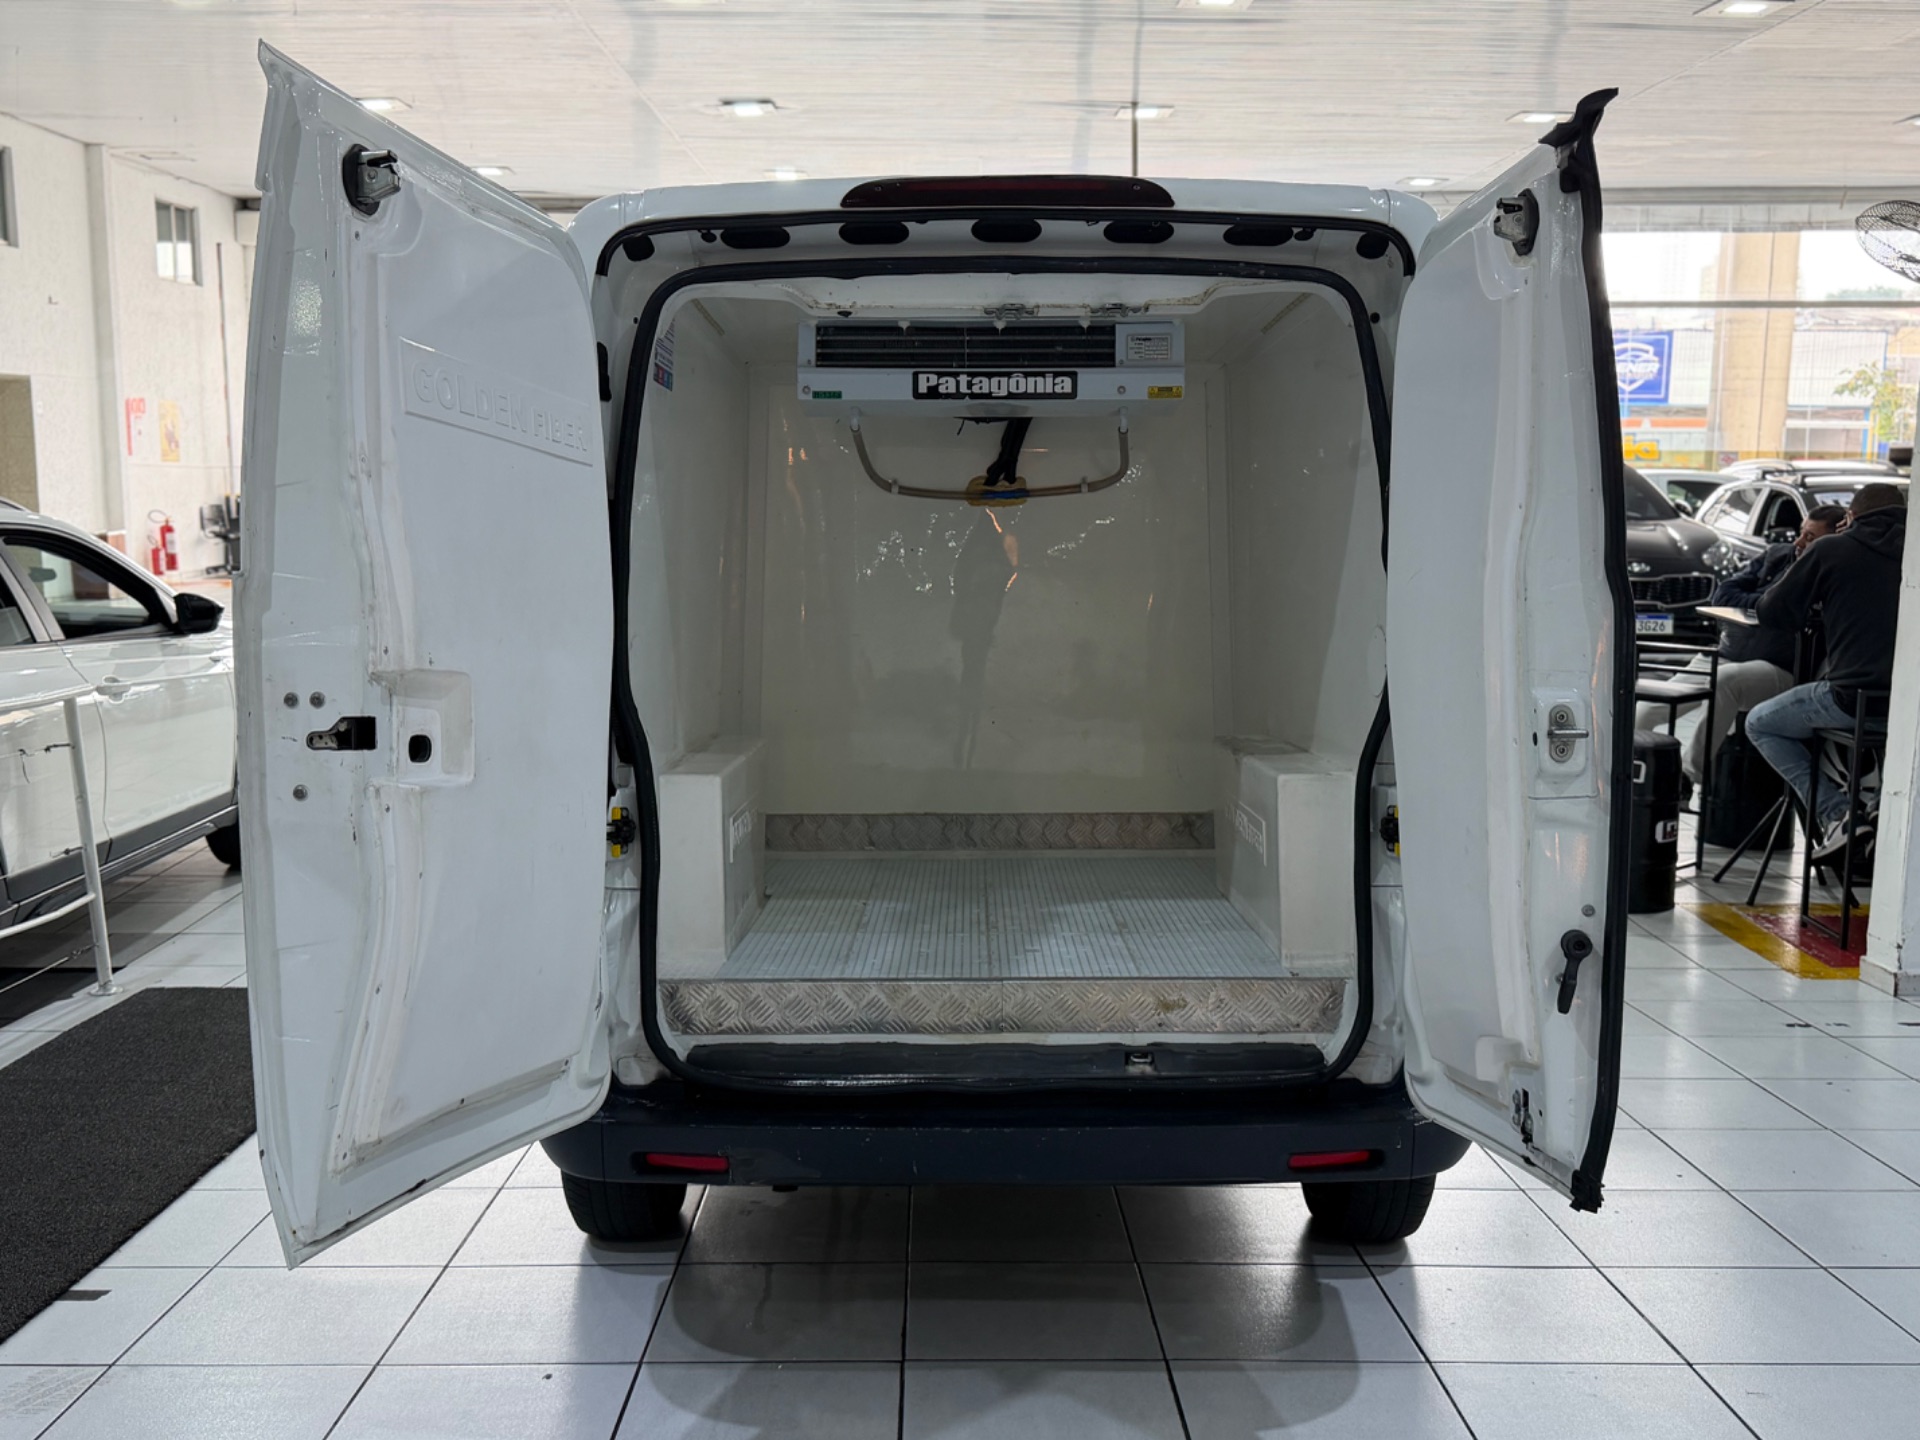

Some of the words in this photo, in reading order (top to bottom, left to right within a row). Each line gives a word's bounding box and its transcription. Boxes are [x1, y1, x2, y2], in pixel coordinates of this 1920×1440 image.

[412, 361, 527, 432] GOLDEN
[530, 406, 588, 453] FIBER
[917, 372, 1073, 398] Patagônia
